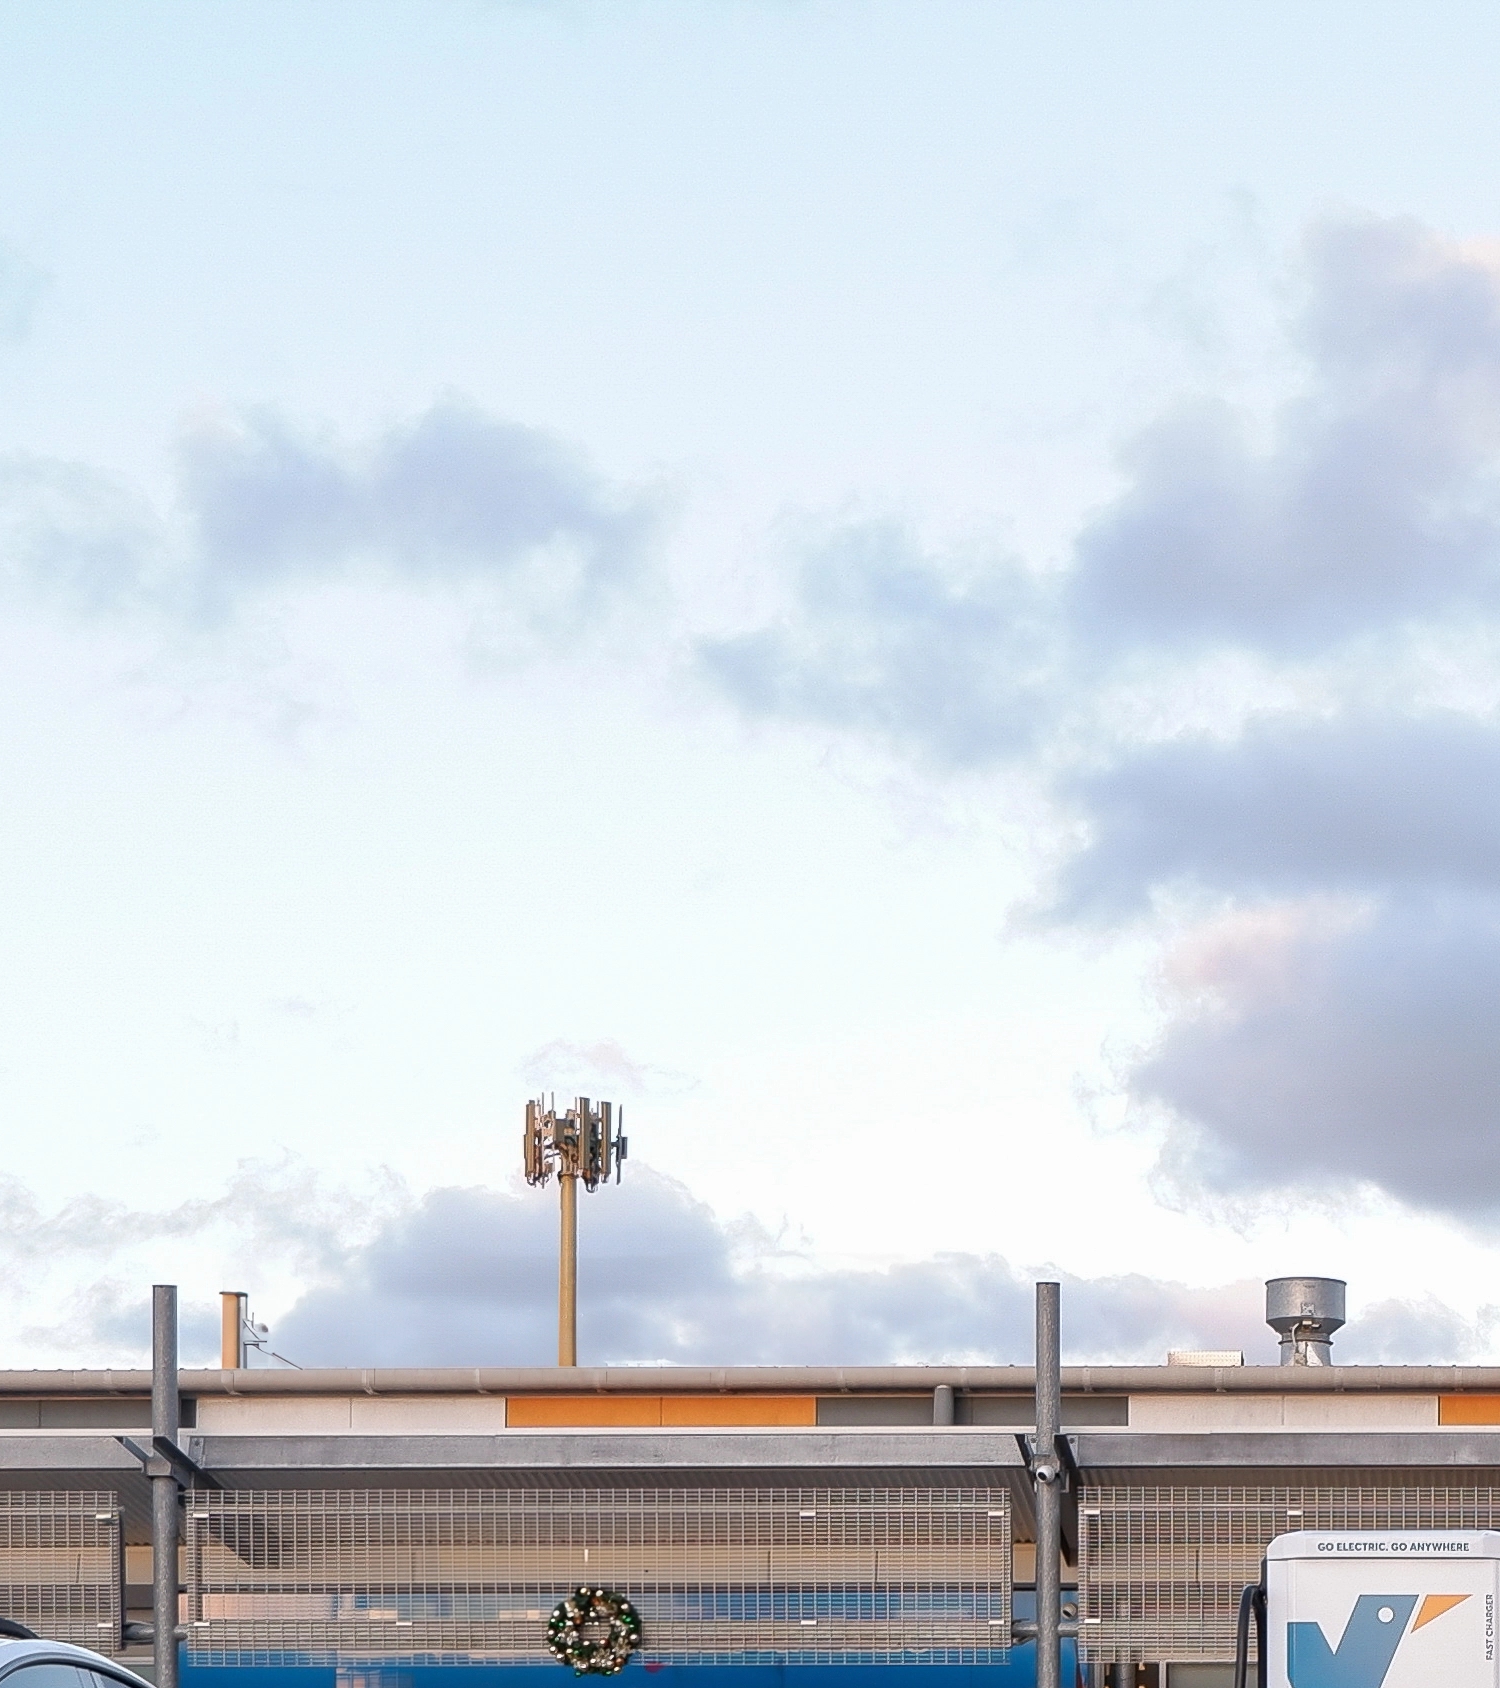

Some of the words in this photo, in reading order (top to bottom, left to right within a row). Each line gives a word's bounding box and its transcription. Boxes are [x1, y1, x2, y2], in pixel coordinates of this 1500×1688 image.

[1317, 1542, 1334, 1552] GO
[1336, 1542, 1389, 1552] ELECTRIC.
[1390, 1542, 1408, 1552] GO
[1409, 1542, 1470, 1552] ANYWHERE
[1485, 1594, 1494, 1637] CHARGER
[1485, 1638, 1494, 1661] FAST
